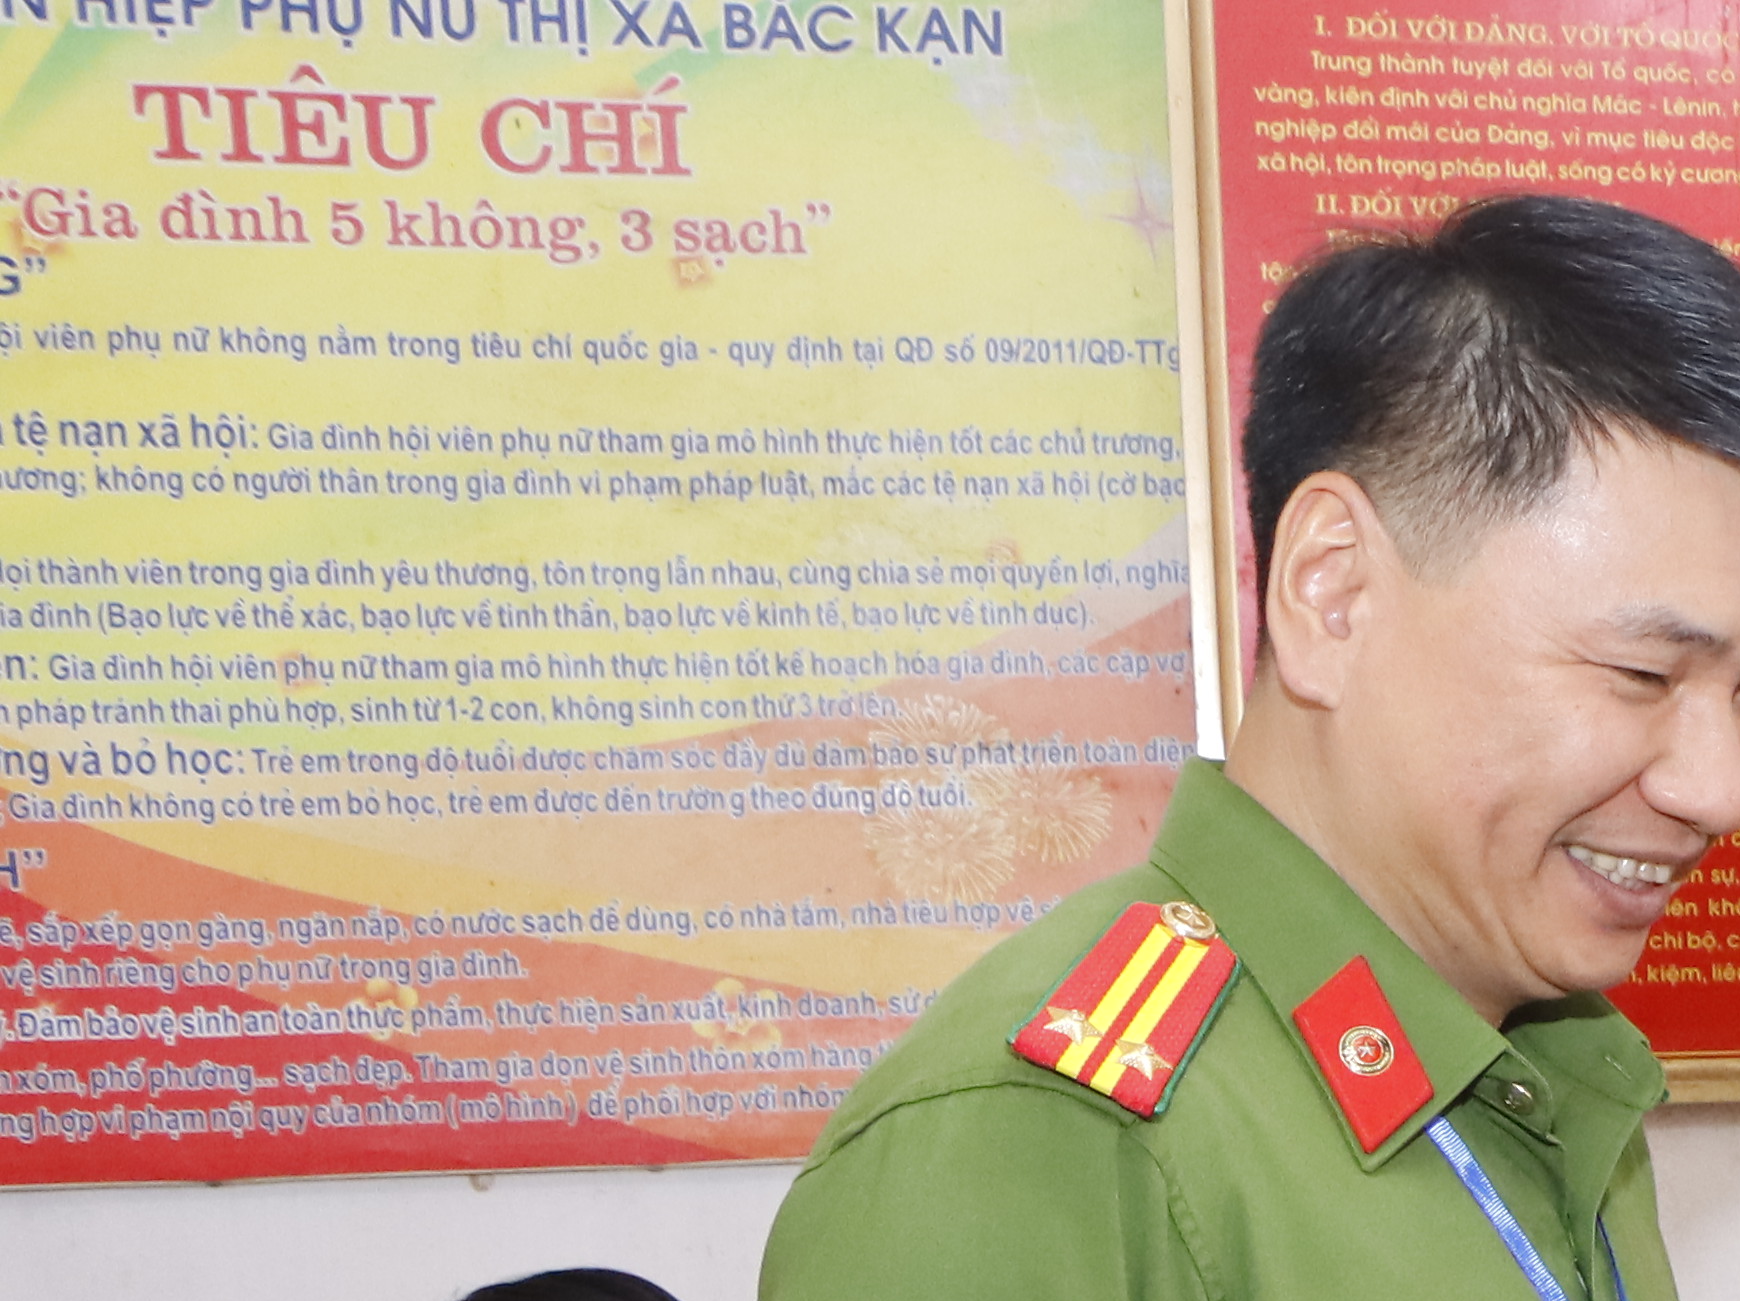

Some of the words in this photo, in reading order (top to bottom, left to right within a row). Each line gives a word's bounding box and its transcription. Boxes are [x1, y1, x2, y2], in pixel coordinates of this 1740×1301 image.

[877, 7, 1003, 66] KẠN
[133, 65, 435, 170] TIÊU
[481, 78, 690, 175] CHÍ
[160, 189, 309, 243] đình
[331, 202, 364, 245] 5
[385, 200, 599, 263] không,
[621, 209, 653, 252] 3
[674, 203, 830, 266] sạch”
[34, 323, 95, 350] viên
[107, 325, 160, 358] phụ
[173, 326, 210, 352] nữ
[219, 326, 306, 361] không
[319, 324, 376, 355] nằm
[387, 332, 460, 364] trong
[471, 332, 520, 358] tiêu
[533, 333, 571, 359] chí
[583, 331, 648, 366] quốc
[660, 335, 698, 367] gia
[728, 342, 774, 368] quy
[787, 336, 843, 368] định
[853, 337, 883, 369] tại
[895, 336, 934, 363] QĐ
[945, 334, 975, 363] số
